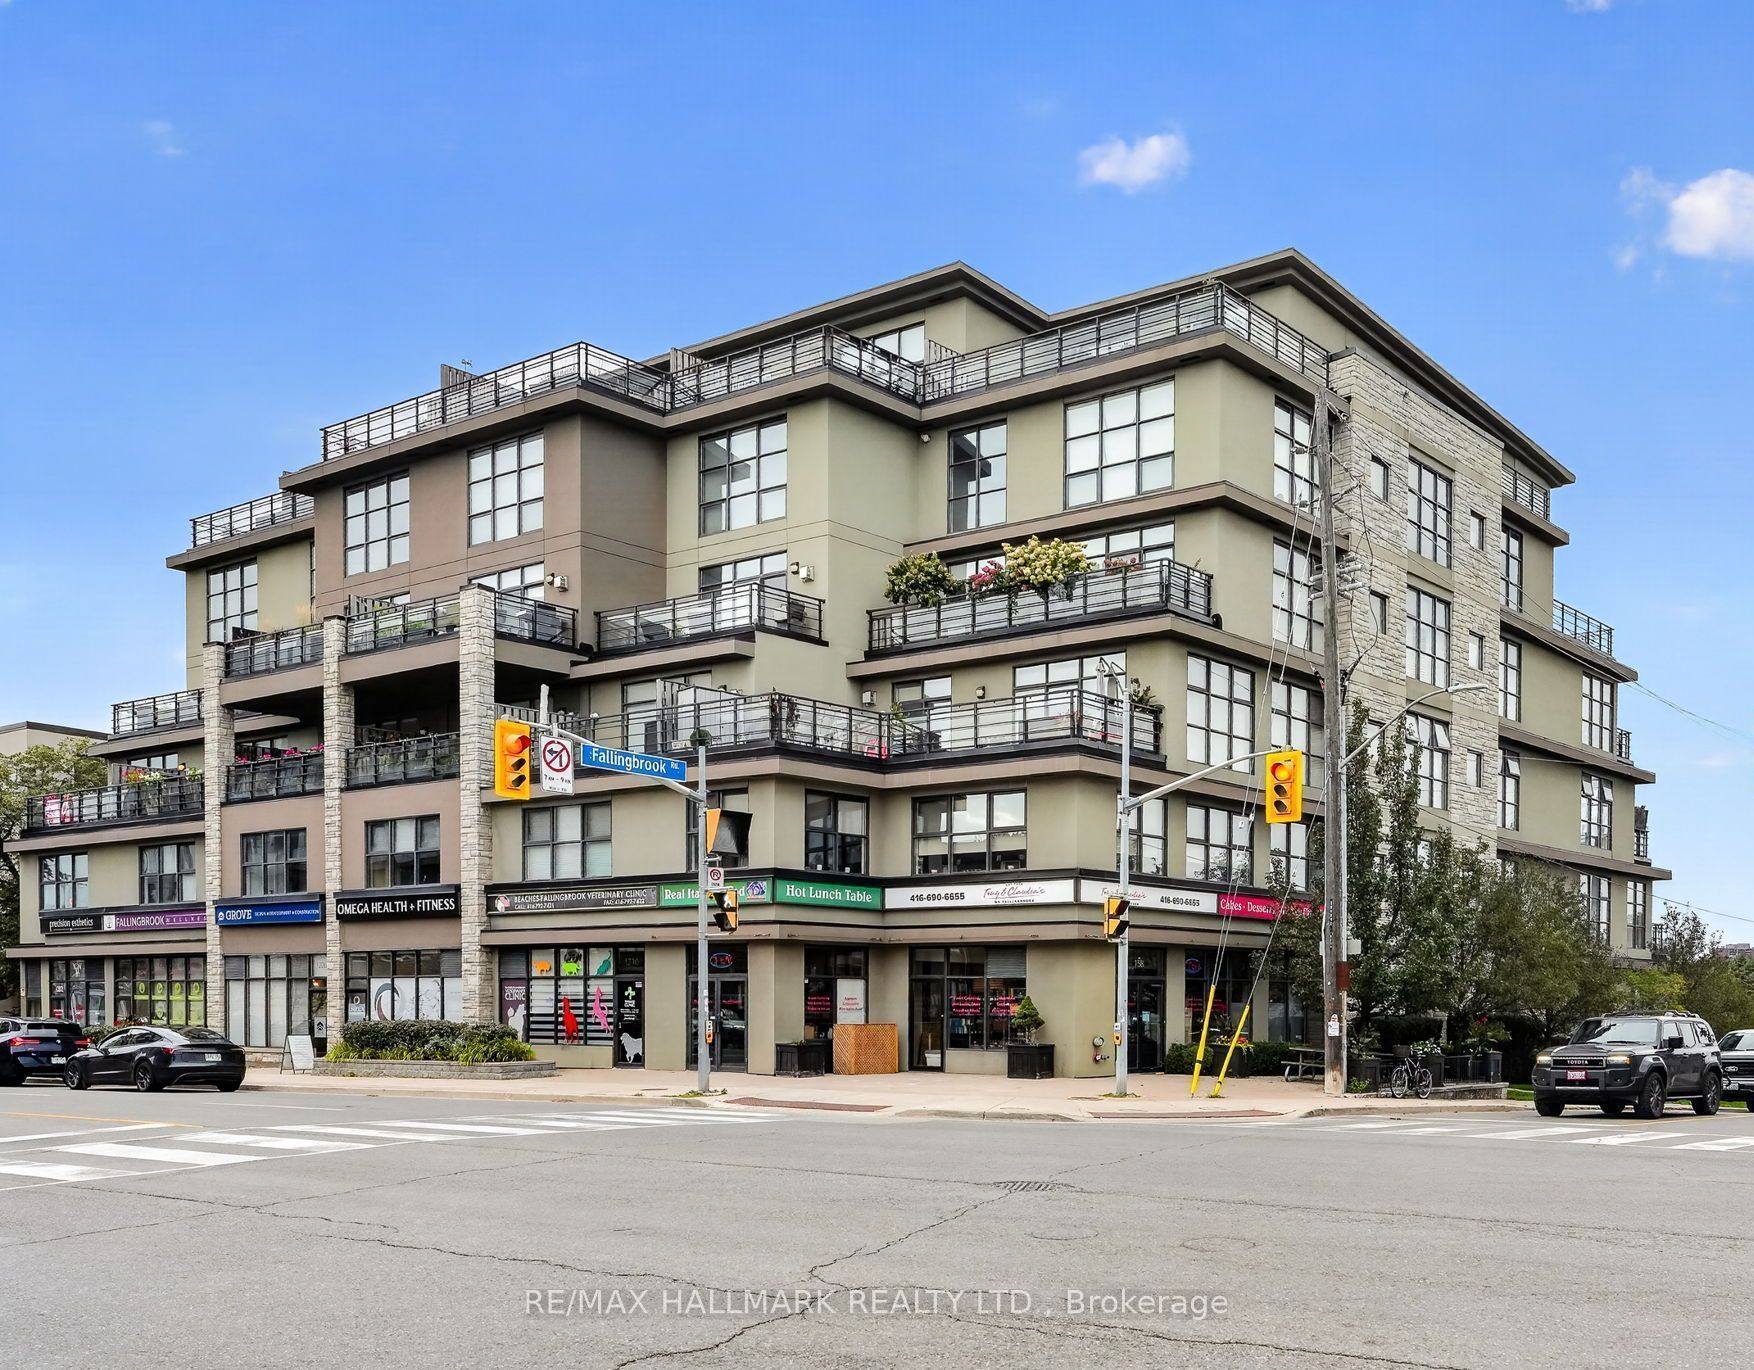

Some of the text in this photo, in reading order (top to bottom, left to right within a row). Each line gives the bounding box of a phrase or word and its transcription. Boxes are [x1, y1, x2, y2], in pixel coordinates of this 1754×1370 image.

[592, 747, 667, 774] Fallingbrook
[587, 890, 625, 900] VETERINARY
[626, 889, 647, 898] CLINIC
[664, 888, 685, 900] Real
[786, 884, 872, 903] Hot Lunch Table
[910, 892, 965, 902] 416-690-6655
[337, 902, 370, 915] OMEGA
[371, 901, 408, 913] HEALTH
[417, 898, 455, 912] FITNESS
[1160, 895, 1200, 907] 416-690-6655
[1220, 898, 1242, 911] Cakes
[225, 909, 252, 921] GROVE
[49, 917, 94, 932] precision esthetics
[116, 915, 165, 928] FALLINGBROOK
[504, 992, 526, 1001] CLINIC
